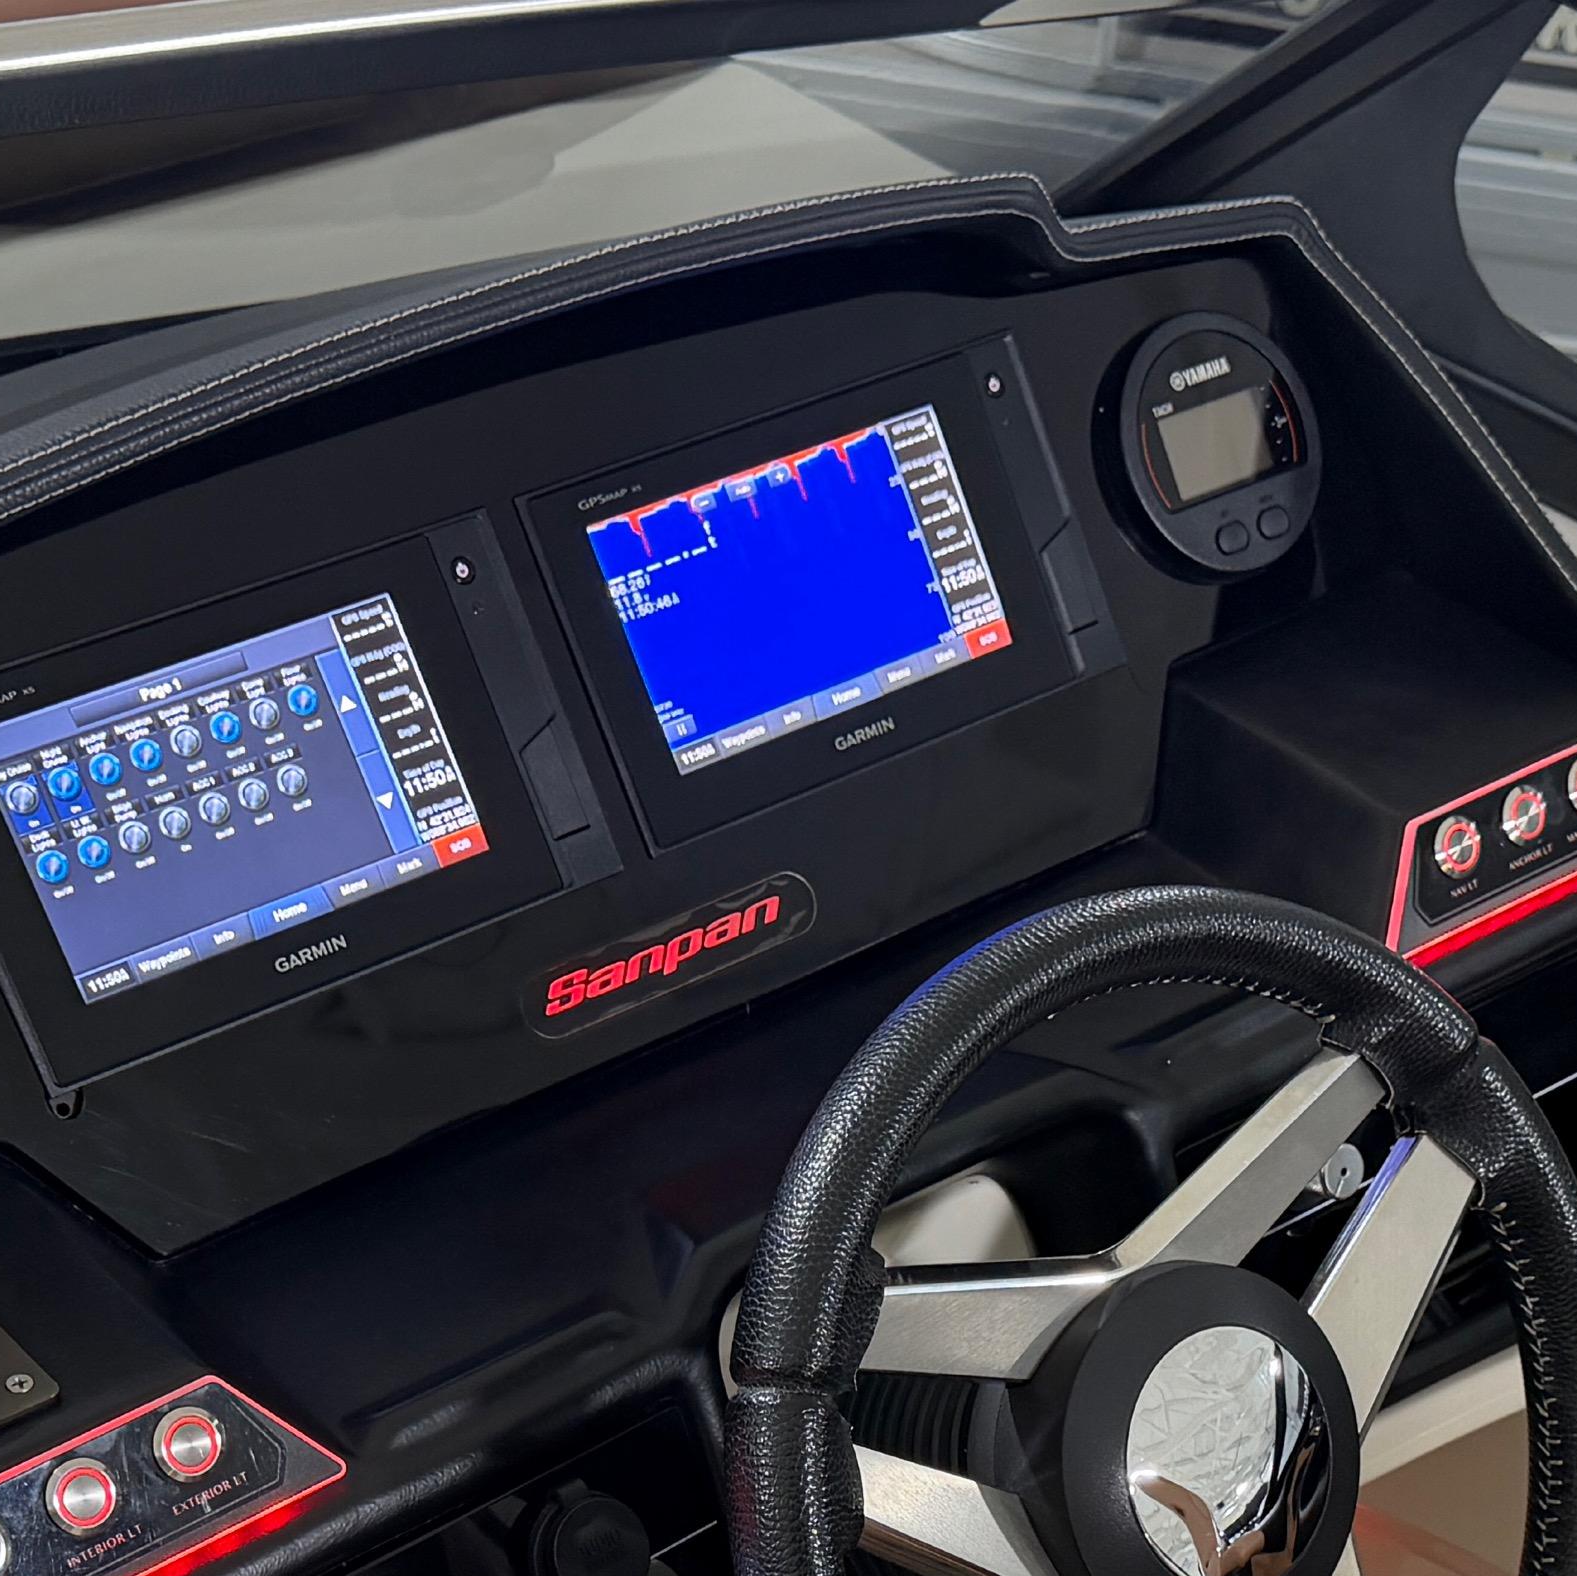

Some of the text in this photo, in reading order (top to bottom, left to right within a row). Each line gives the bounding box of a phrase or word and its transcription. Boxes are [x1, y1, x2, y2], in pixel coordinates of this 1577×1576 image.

[1183, 356, 1231, 386] YAMAHA
[577, 487, 628, 511] GPSMAP
[138, 676, 183, 704] Page 1
[831, 684, 861, 706] Home
[834, 717, 895, 751] GARMIN
[401, 763, 457, 798] 11:50A
[137, 942, 193, 977] Waypoints
[271, 898, 309, 924] Home
[338, 876, 369, 898] Menu
[274, 936, 347, 975] GARMIN
[545, 895, 780, 1017] Sanpan
[171, 1470, 249, 1517] EXTERIOR LT
[67, 1524, 143, 1569] INTERIOR LT
